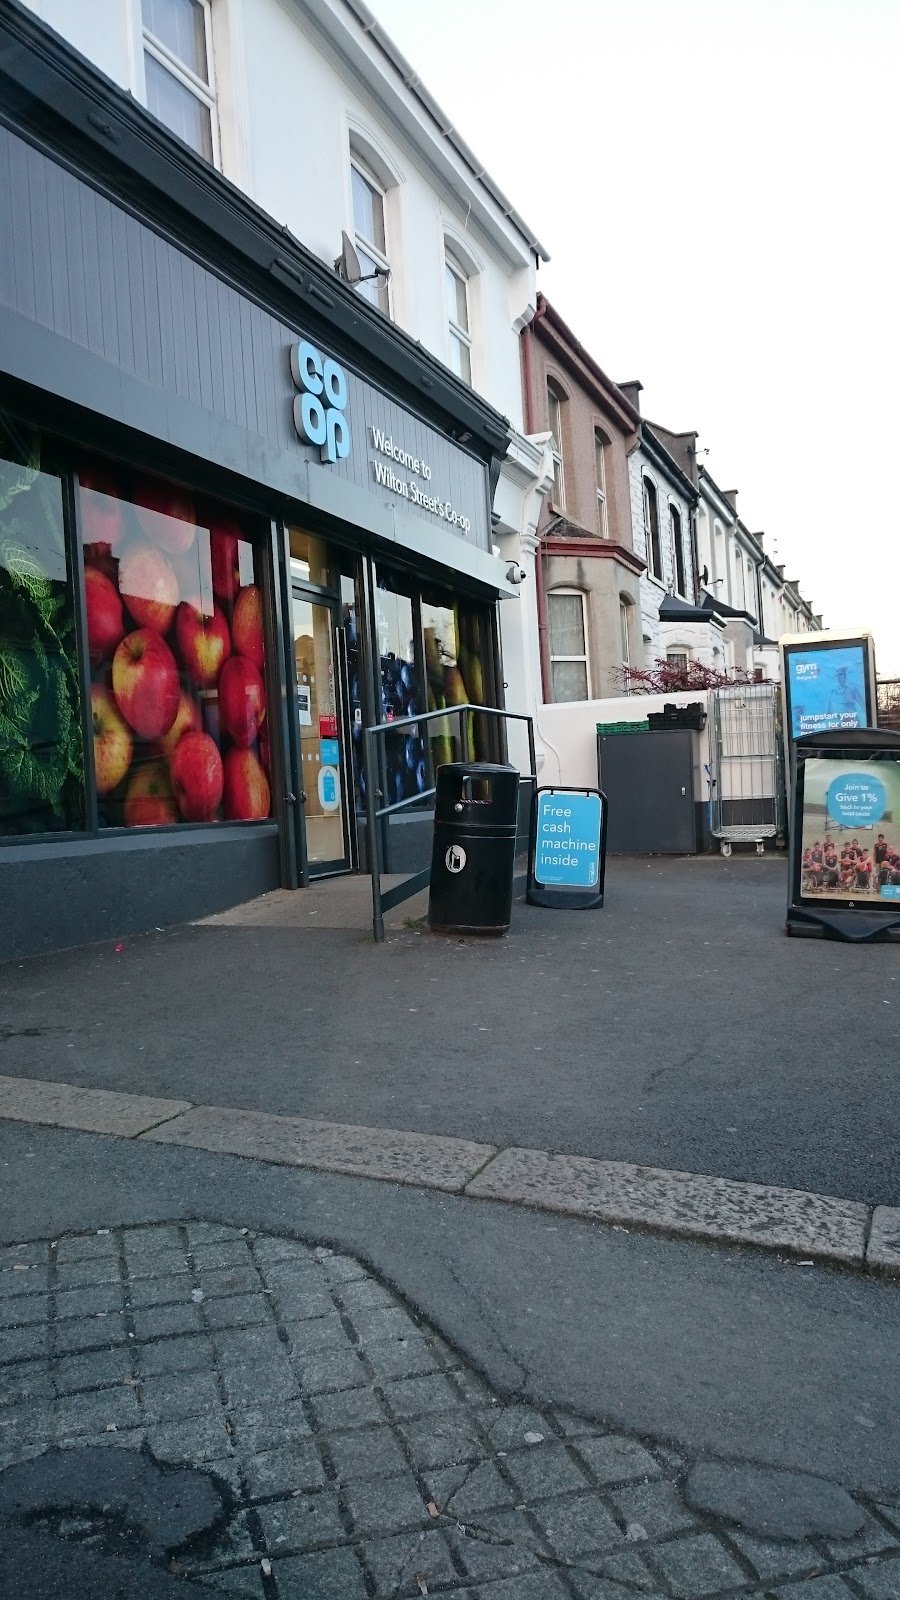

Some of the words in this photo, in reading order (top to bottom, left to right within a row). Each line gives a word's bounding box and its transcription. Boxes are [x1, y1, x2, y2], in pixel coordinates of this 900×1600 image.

[372, 425, 420, 474] Welcome
[421, 460, 432, 480] to
[374, 460, 409, 497] Wilton
[410, 482, 445, 517] Street's
[445, 502, 471, 535] Co-op
[796, 663, 817, 674] gym
[800, 712, 838, 723] jumpstart
[839, 711, 857, 720] your
[800, 722, 826, 730] fitness
[841, 719, 858, 728] only
[835, 793, 859, 802] Give
[861, 793, 878, 802] 1%
[543, 804, 572, 817] Free
[542, 821, 571, 833] cash
[542, 838, 596, 851] machine
[541, 853, 579, 867] inside
